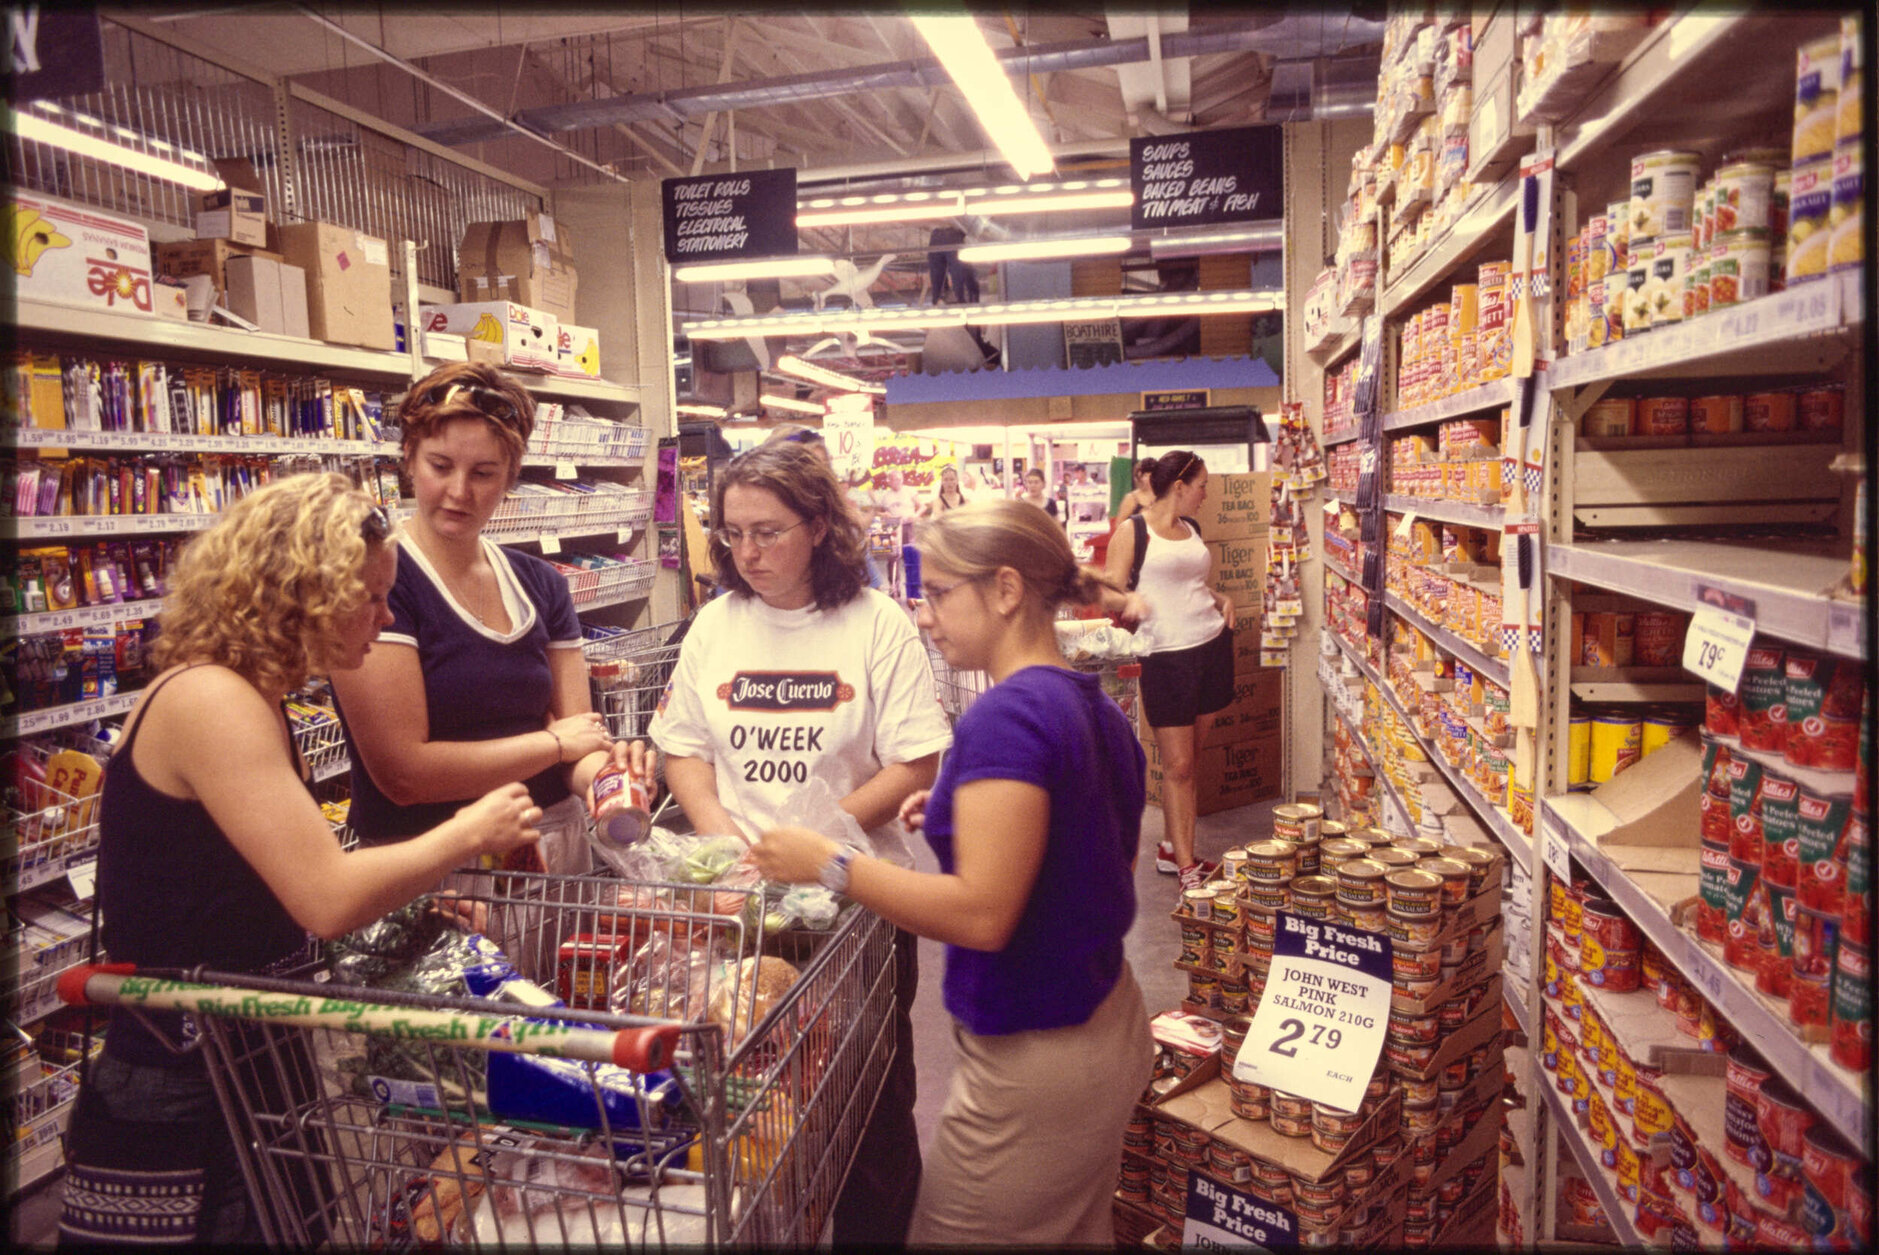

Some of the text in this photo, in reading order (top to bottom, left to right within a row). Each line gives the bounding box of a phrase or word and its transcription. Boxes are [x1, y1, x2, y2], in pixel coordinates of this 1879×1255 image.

[1142, 142, 1190, 162] SOUPS
[1142, 160, 1194, 181] SAUCES
[674, 180, 751, 200] TOILET ROLLS
[1143, 176, 1237, 200] BAKED BEANS
[676, 200, 733, 218] TISSUES
[1223, 192, 1260, 213] FISH
[677, 216, 748, 236] ELECTRICAL
[677, 232, 749, 252] STATIONERY
[87, 266, 153, 312] Dole
[509, 304, 530, 323] Dole
[1221, 474, 1256, 499] Tiger
[1222, 501, 1235, 511] TEA
[1219, 543, 1254, 568] Tiger
[733, 677, 833, 705] Jose Cuervo
[730, 725, 825, 752] O'WEEK
[1223, 746, 1259, 769] Tiger
[744, 760, 808, 784] 2000
[1285, 915, 1383, 953] Big Fresh
[1305, 939, 1360, 966] Price
[1282, 967, 1370, 999] JOHN WEST
[1297, 986, 1338, 1006] PINK
[1273, 994, 1375, 1030] SALMON 210G
[1325, 1069, 1354, 1084] EACH
[1196, 1178, 1290, 1232] Big Fresh
[1212, 1206, 1268, 1242] Price
